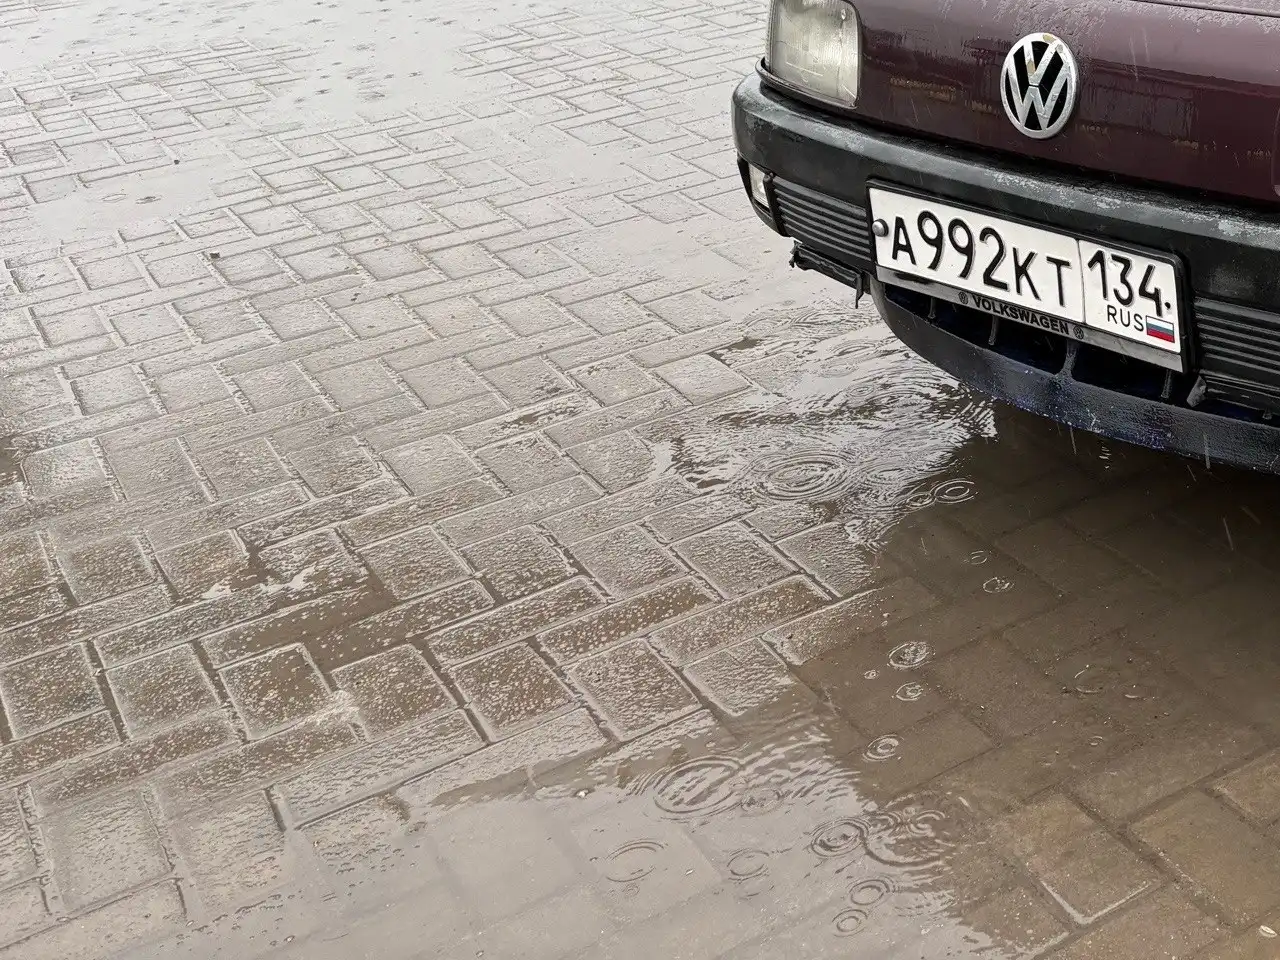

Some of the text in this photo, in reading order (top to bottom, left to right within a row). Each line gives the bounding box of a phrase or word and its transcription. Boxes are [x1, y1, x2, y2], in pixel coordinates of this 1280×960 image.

[1002, 34, 1075, 137] VW
[1087, 249, 1162, 317] 134
[971, 294, 1070, 335] VOLKSWAGEN
[1107, 305, 1145, 332] RUS
